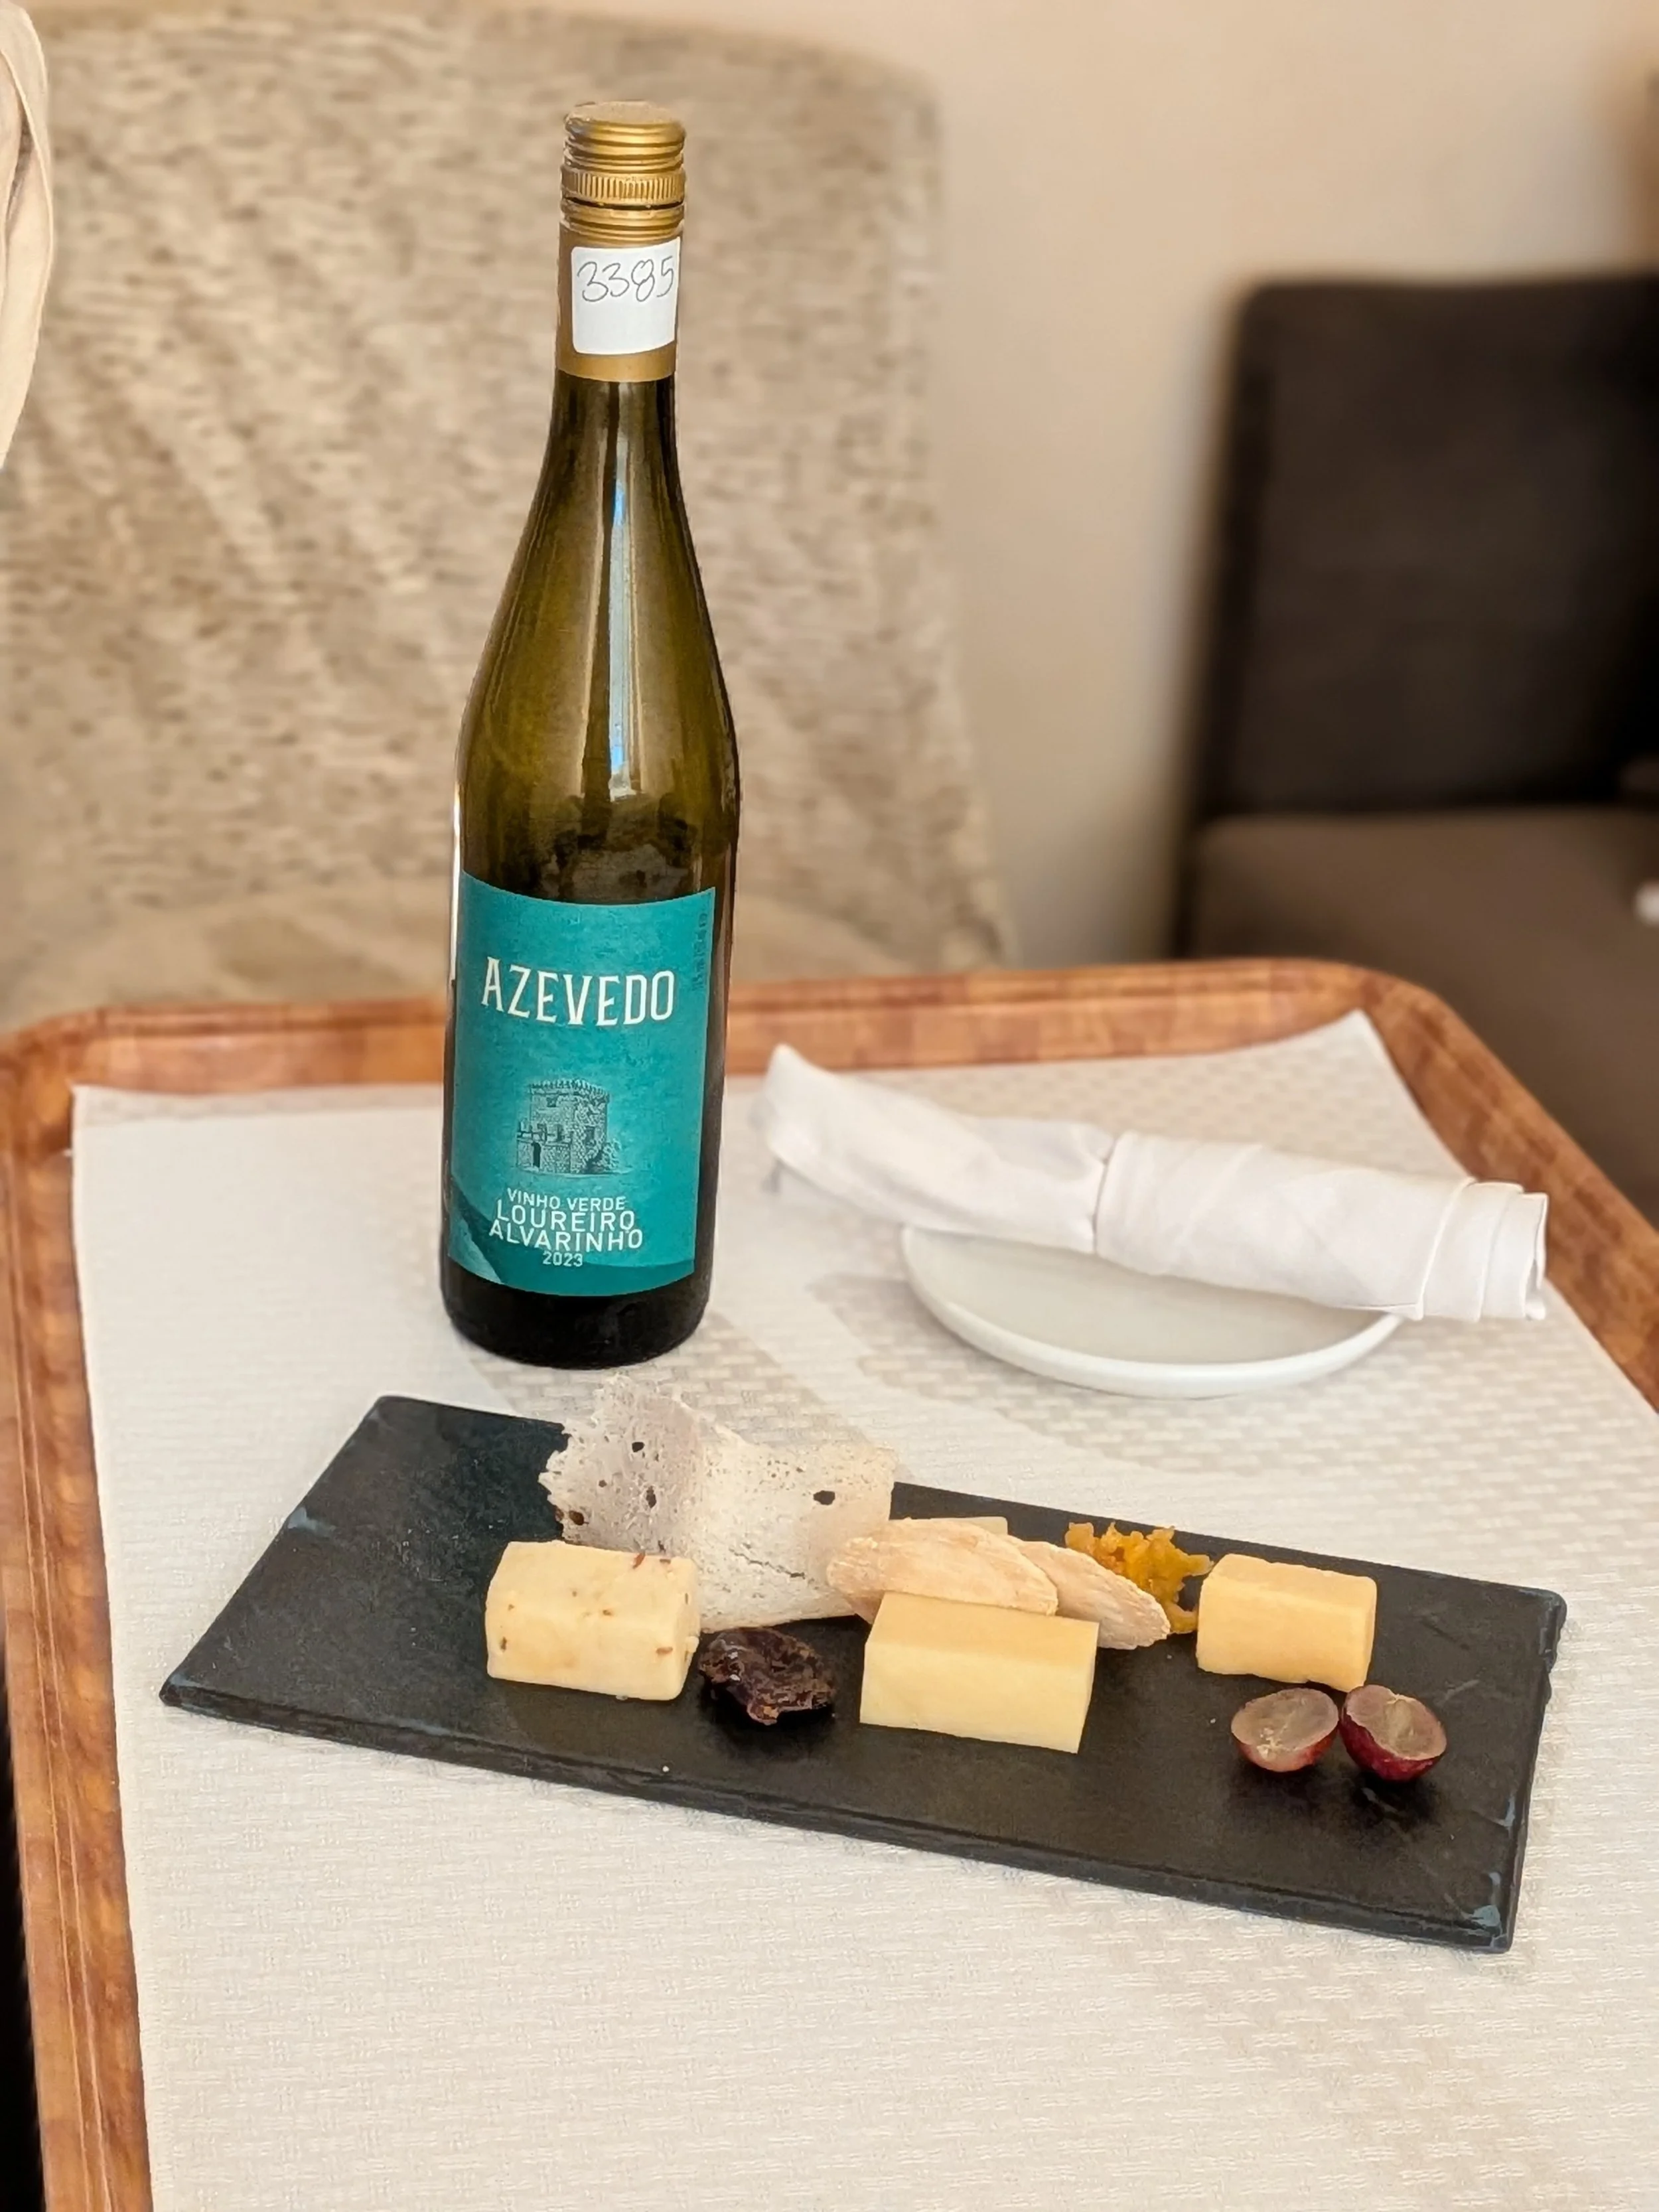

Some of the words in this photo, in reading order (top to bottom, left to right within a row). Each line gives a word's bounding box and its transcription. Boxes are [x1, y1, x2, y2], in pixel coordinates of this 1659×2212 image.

[576, 256, 674, 302] 3385
[481, 956, 676, 1027] AZEVEDO
[497, 1199, 635, 1232] LOUREIRO
[507, 1187, 561, 1210] VINHO
[567, 1196, 626, 1212] VERDE
[488, 1219, 643, 1252] ALVARINHO
[542, 1251, 583, 1267] 2023
